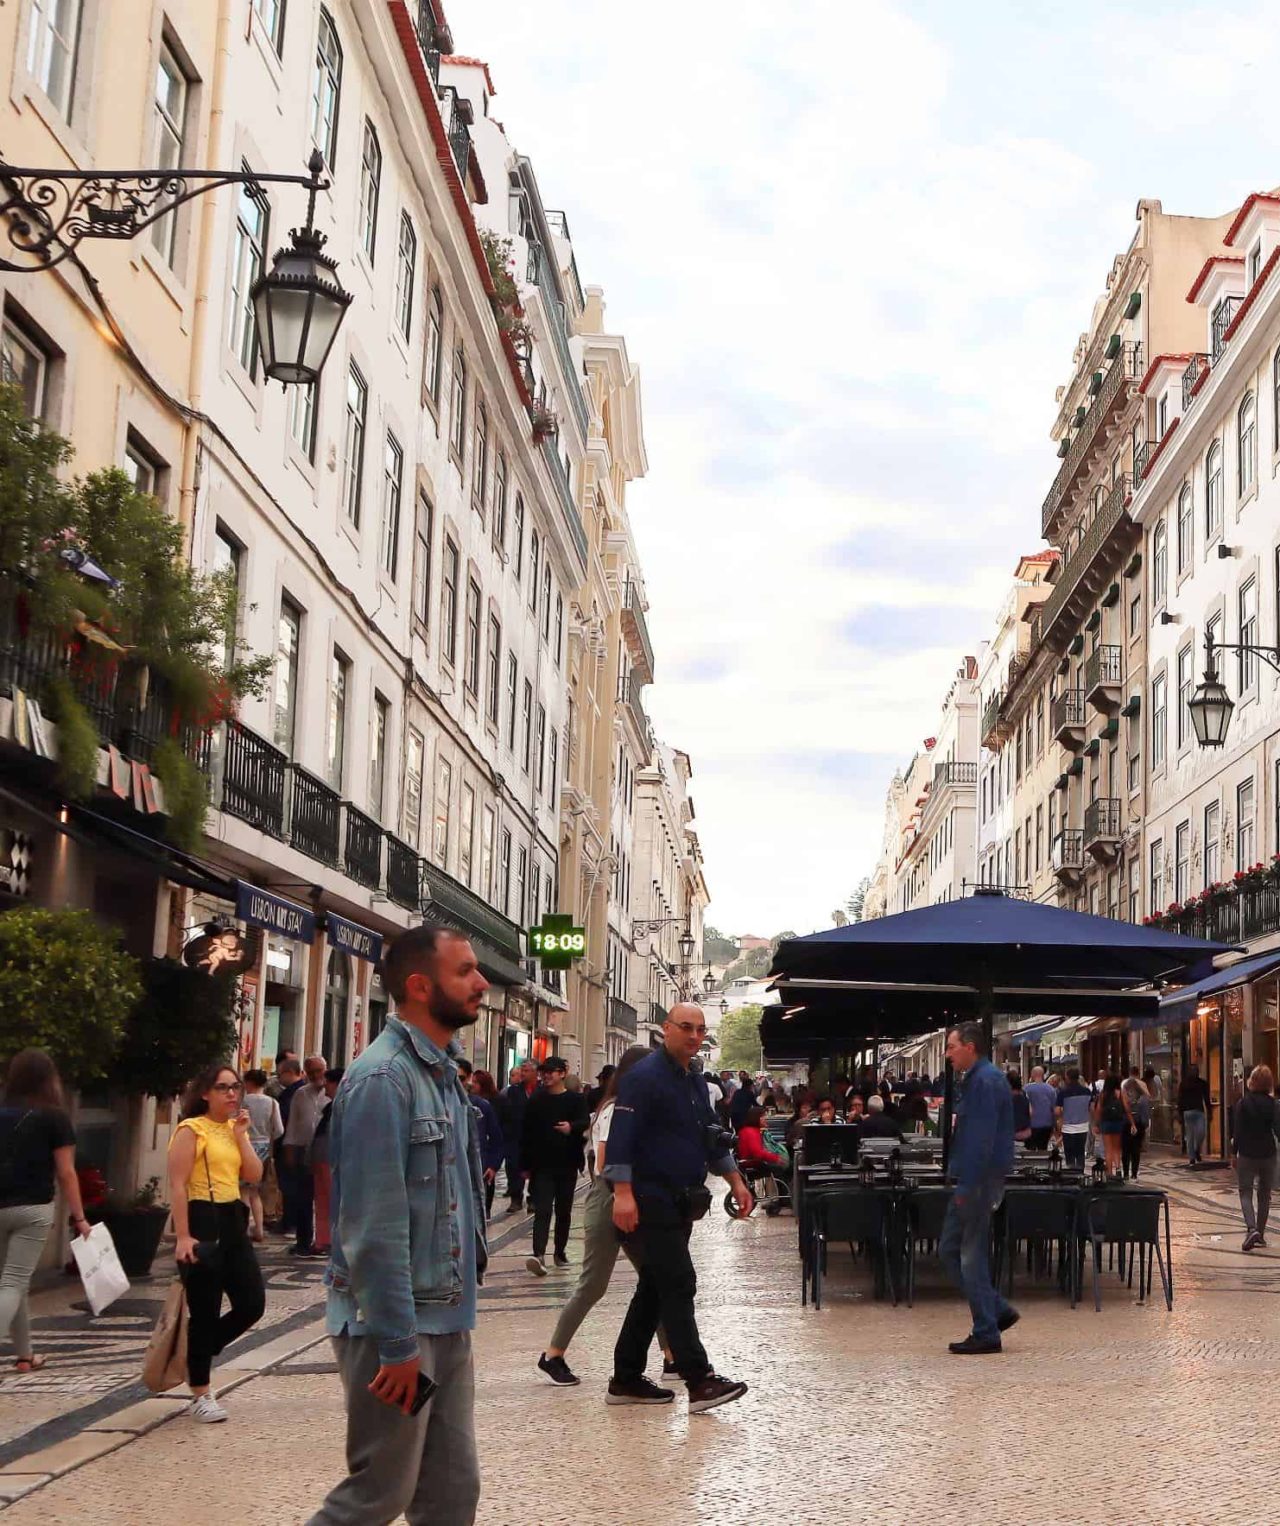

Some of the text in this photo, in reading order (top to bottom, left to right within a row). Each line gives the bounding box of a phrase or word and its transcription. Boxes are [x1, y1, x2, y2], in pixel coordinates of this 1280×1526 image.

[250, 894, 276, 926] LISBON
[288, 910, 303, 933] STAY
[533, 933, 585, 951] 18:09
